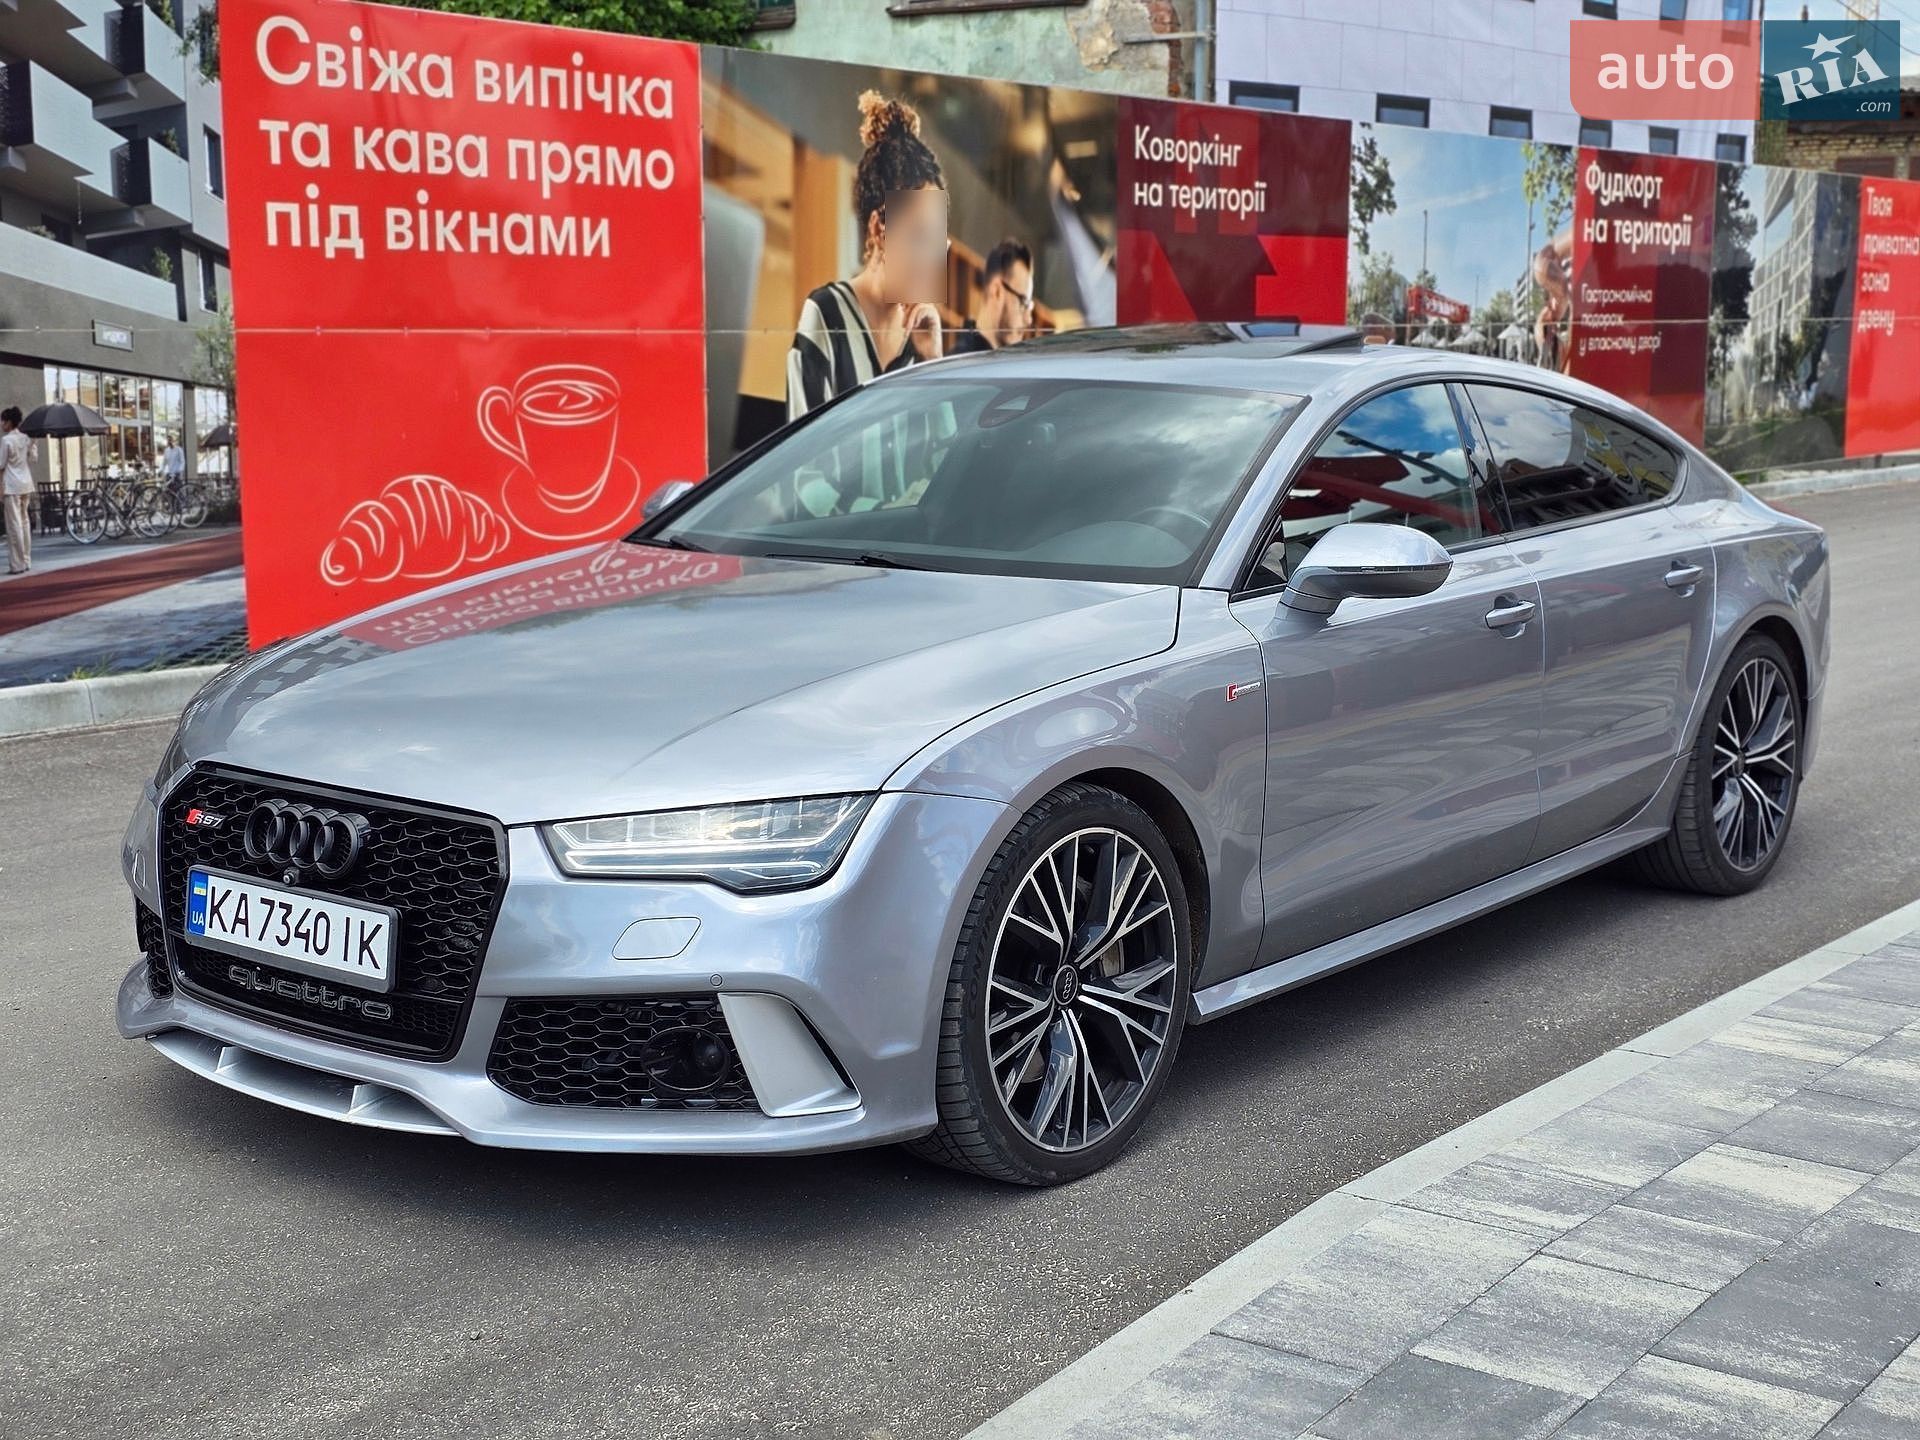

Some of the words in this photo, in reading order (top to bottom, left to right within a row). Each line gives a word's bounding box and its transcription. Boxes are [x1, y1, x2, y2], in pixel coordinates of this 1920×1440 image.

[256, 15, 454, 98] Свіжа
[475, 51, 673, 119] випічка
[259, 119, 331, 168] та
[354, 126, 489, 178] кава
[508, 138, 675, 199] прямо
[1134, 124, 1242, 173] Коворкінг
[1134, 182, 1163, 207] на
[1169, 181, 1267, 221] території
[1585, 160, 1663, 208] Фудкорт
[1866, 186, 1893, 217] Твоя
[266, 183, 365, 259] під
[386, 189, 610, 257] вікнами
[1583, 218, 1608, 243] на
[1613, 214, 1693, 255] території
[1861, 271, 1890, 292] зона
[1857, 309, 1896, 336] дзену
[1579, 337, 1587, 356] у
[188, 809, 224, 827] RS7
[191, 910, 205, 926] UA
[208, 885, 250, 938] KA
[258, 898, 331, 956] 7340
[343, 916, 384, 970] IK
[228, 965, 392, 1020] quattro
